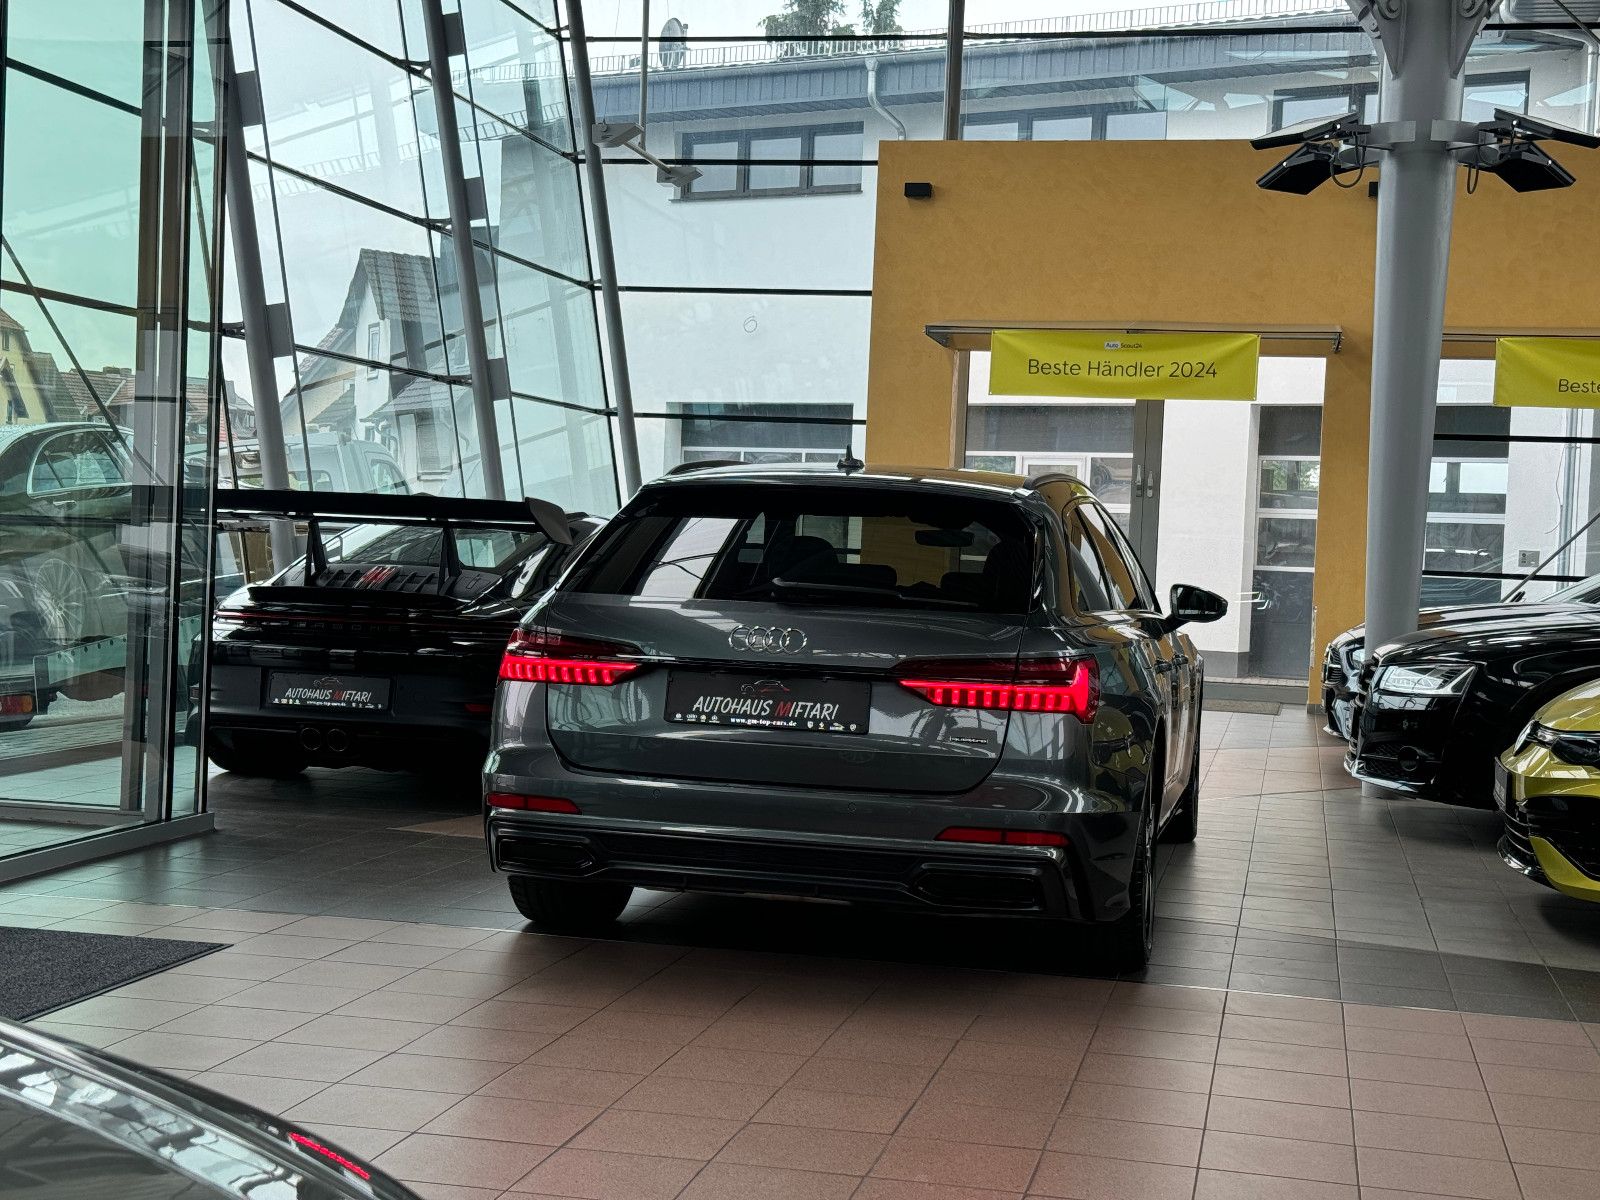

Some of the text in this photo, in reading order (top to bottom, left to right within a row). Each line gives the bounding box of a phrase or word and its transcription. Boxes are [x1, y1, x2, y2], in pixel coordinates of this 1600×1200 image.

[1028, 359, 1217, 378] Beste Händler 2024
[285, 687, 372, 703] AUTOHAUS MIFTARI
[692, 696, 839, 720] AUTOHAUS MIFTARI
[730, 717, 798, 727] www.gm-top-cars.de
